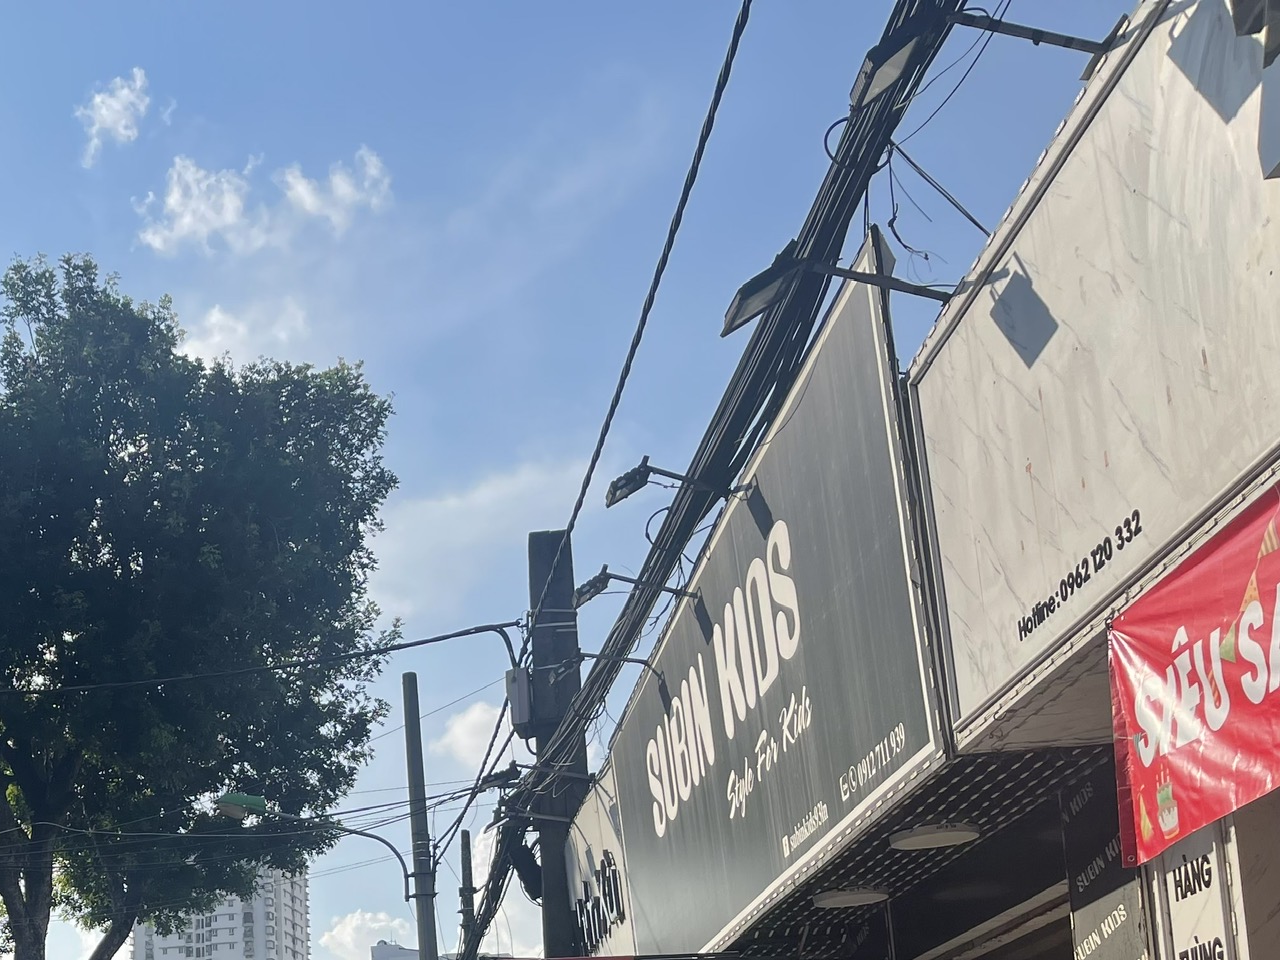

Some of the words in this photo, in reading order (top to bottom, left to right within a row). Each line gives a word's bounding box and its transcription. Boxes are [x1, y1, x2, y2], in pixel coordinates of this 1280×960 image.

[1060, 557, 1091, 602] 0962
[1114, 508, 1142, 550] 332
[646, 652, 715, 838] SUBIN
[713, 519, 802, 740] KIDS
[727, 756, 755, 820] Style
[754, 729, 780, 782] For
[779, 685, 813, 753] Kids
[1075, 856, 1106, 893] SUBIN
[1173, 854, 1212, 902] HÀNG
[1100, 904, 1128, 939] KIDS
